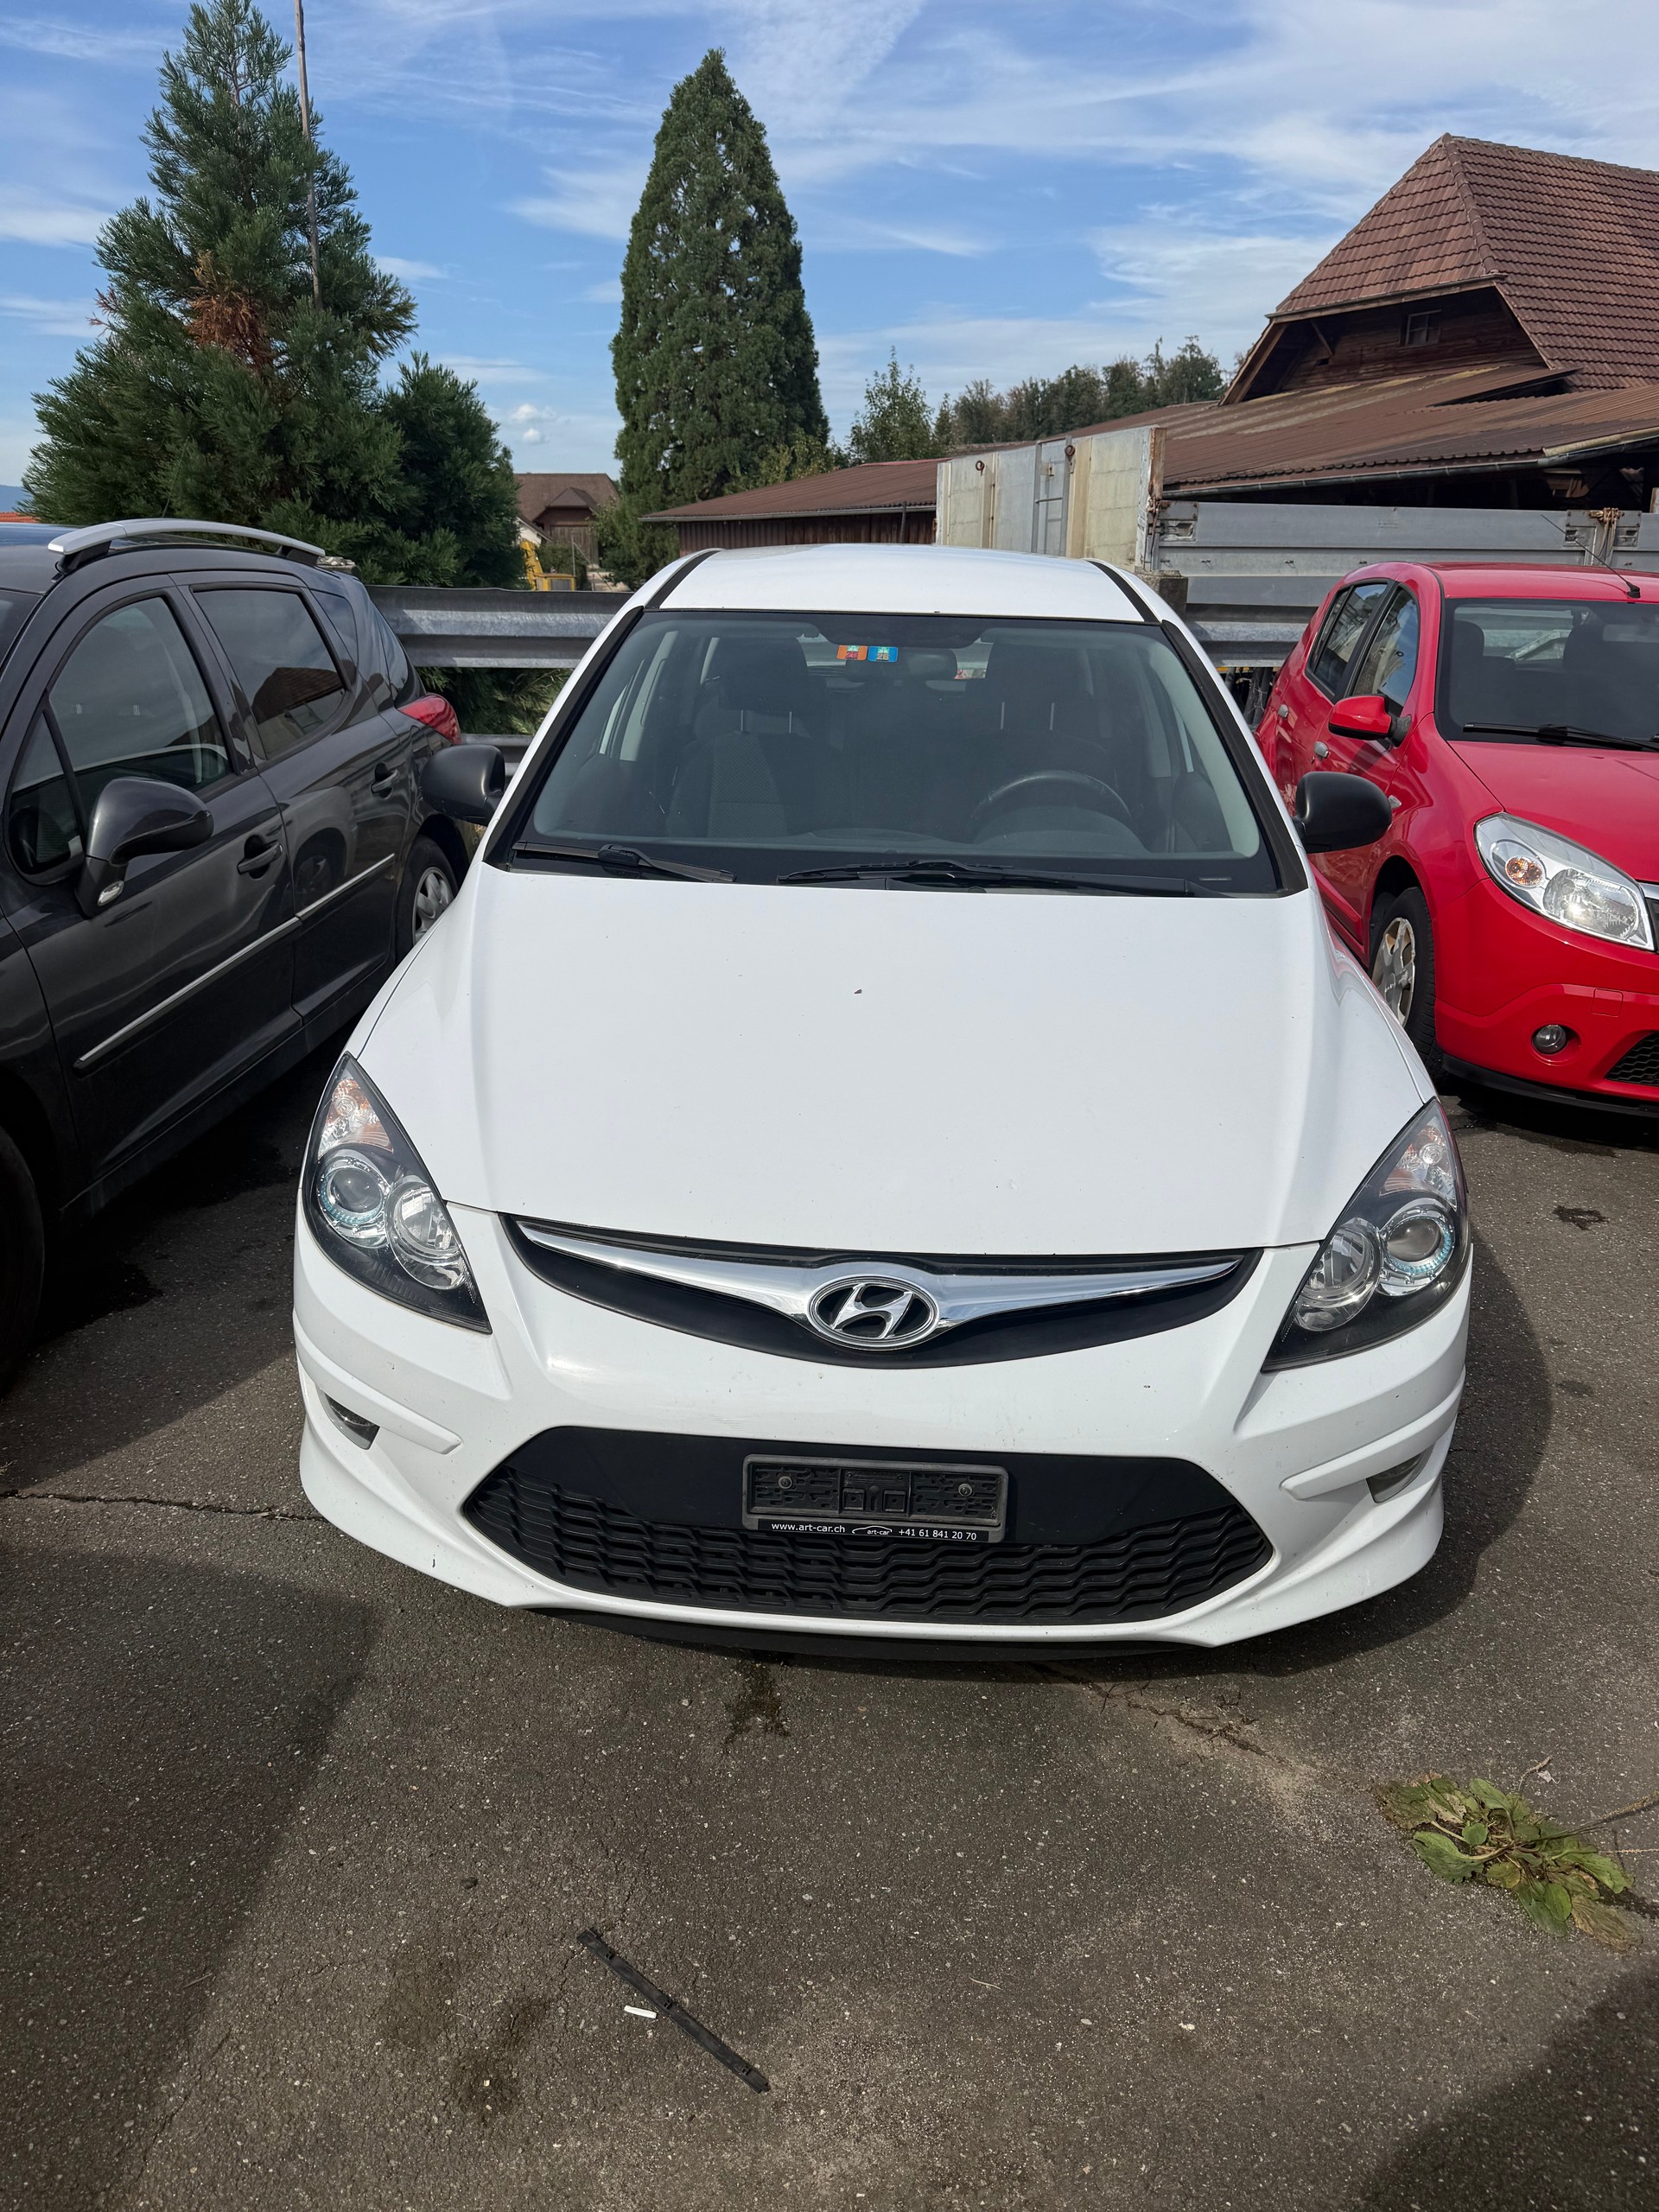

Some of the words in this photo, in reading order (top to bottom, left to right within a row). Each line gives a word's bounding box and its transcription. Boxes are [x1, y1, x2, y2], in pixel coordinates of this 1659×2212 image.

[772, 1523, 845, 1533] www.art-car.ch
[932, 1529, 949, 1538] 841
[951, 1531, 963, 1540] 20
[966, 1532, 977, 1541] 70
